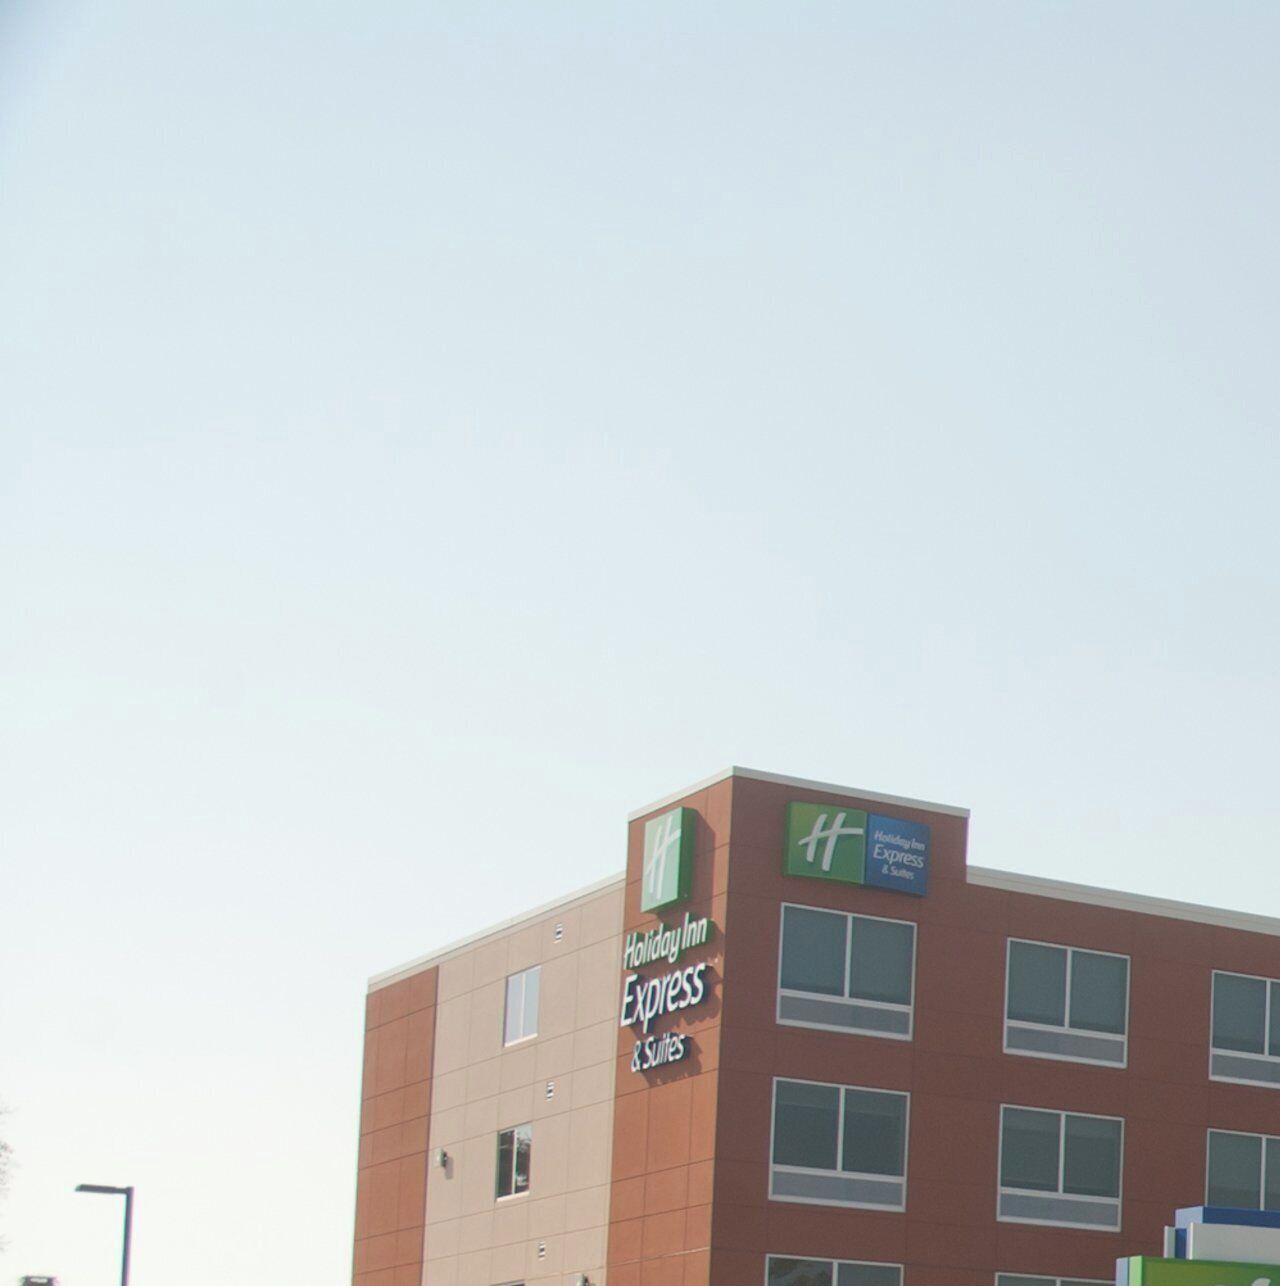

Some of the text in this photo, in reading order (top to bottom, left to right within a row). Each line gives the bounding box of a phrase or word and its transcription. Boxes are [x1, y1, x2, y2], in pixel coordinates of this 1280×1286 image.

[873, 845, 924, 868] Express
[875, 831, 925, 850] Holiday Inn
[882, 865, 914, 879] & Suites
[623, 912, 708, 970] Holiday Inn
[620, 962, 706, 1033] Express
[631, 1032, 686, 1073] & Suites
